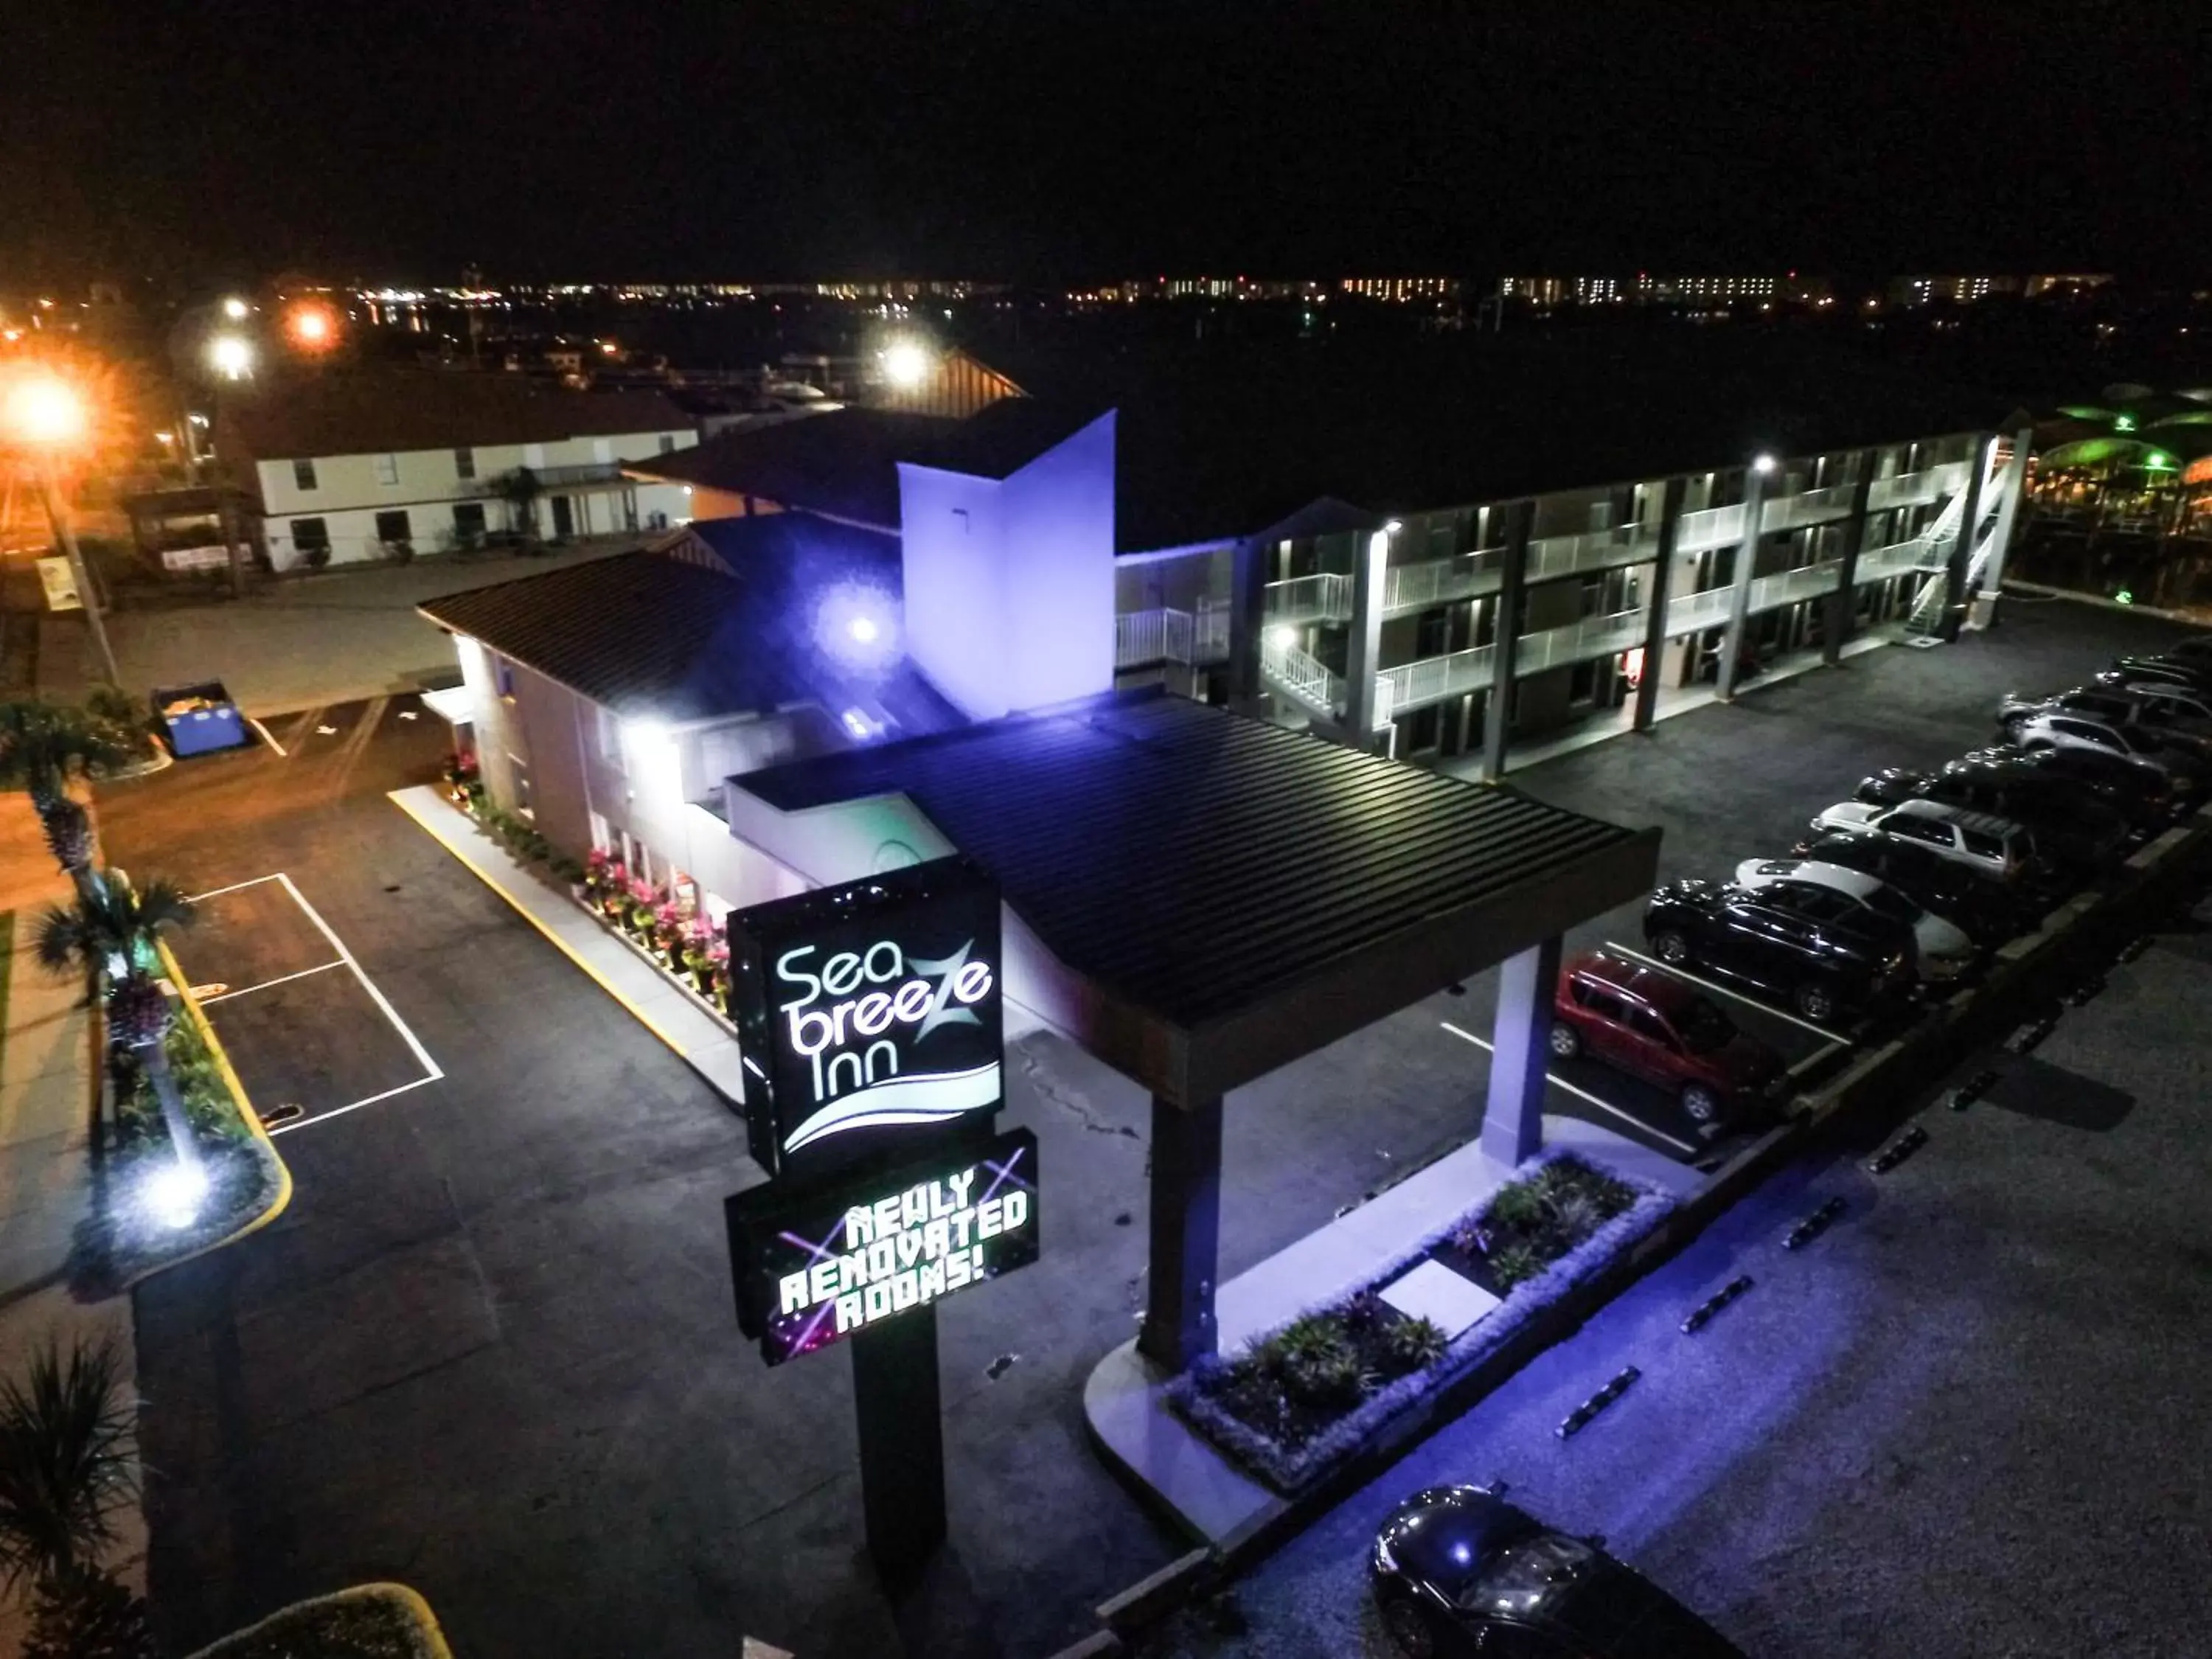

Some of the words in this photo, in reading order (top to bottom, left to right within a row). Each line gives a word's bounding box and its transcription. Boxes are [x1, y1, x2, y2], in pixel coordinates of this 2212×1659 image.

[776, 940, 903, 1012] Sea
[812, 1040, 898, 1101] Inn
[845, 1168, 975, 1249] NEWLY
[779, 1190, 1027, 1315] RENOVATED
[835, 1244, 985, 1334] ROOMS!
